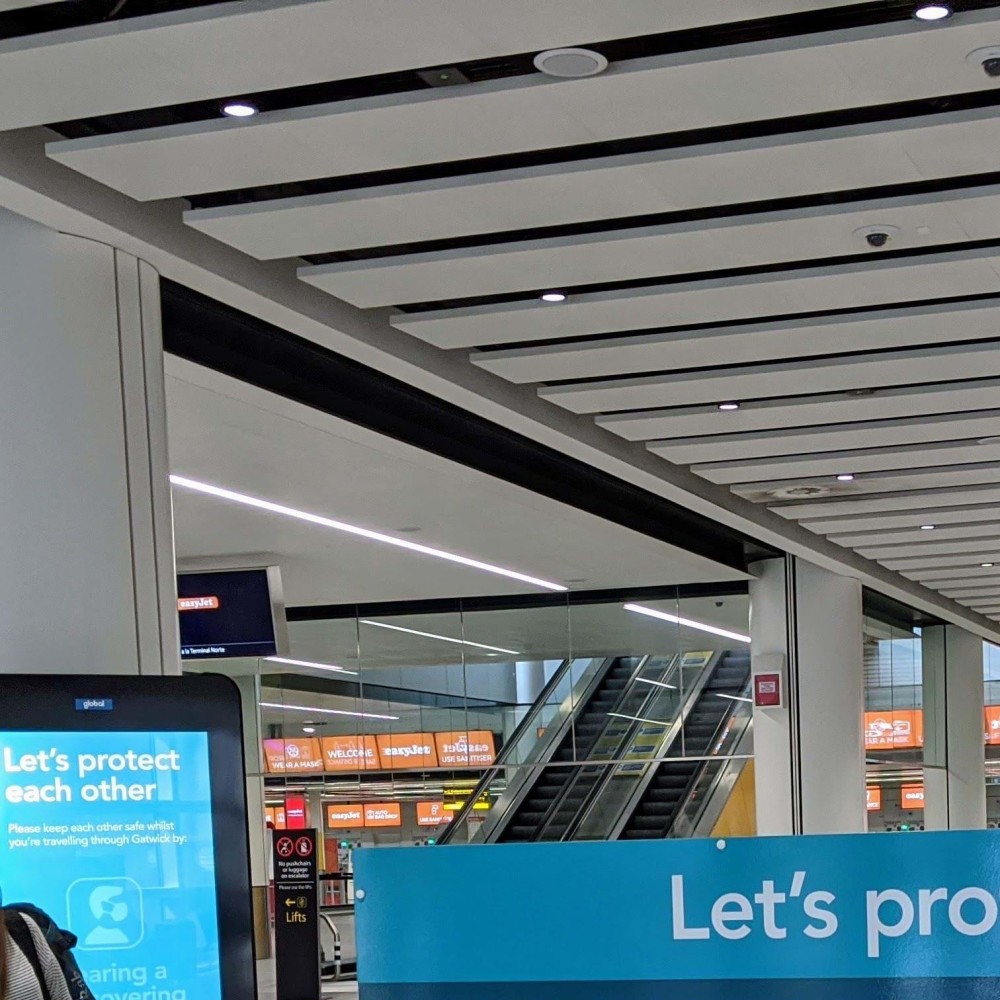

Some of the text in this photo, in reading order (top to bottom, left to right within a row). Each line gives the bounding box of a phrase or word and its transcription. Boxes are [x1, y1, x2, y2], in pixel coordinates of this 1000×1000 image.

[180, 598, 213, 608] easyJet
[83, 699, 104, 710] global
[327, 748, 373, 758] WELCOME
[384, 745, 431, 757] easyJet
[3, 747, 181, 778] Let's protect
[5, 775, 157, 803] each other
[332, 811, 360, 820] easyJet
[8, 820, 175, 835] Please keep each other safe whilst
[8, 833, 187, 849] you're travelling through Gatwick by:
[671, 870, 838, 940] Let's
[286, 911, 307, 923] Lifts
[86, 963, 167, 986] aring a
